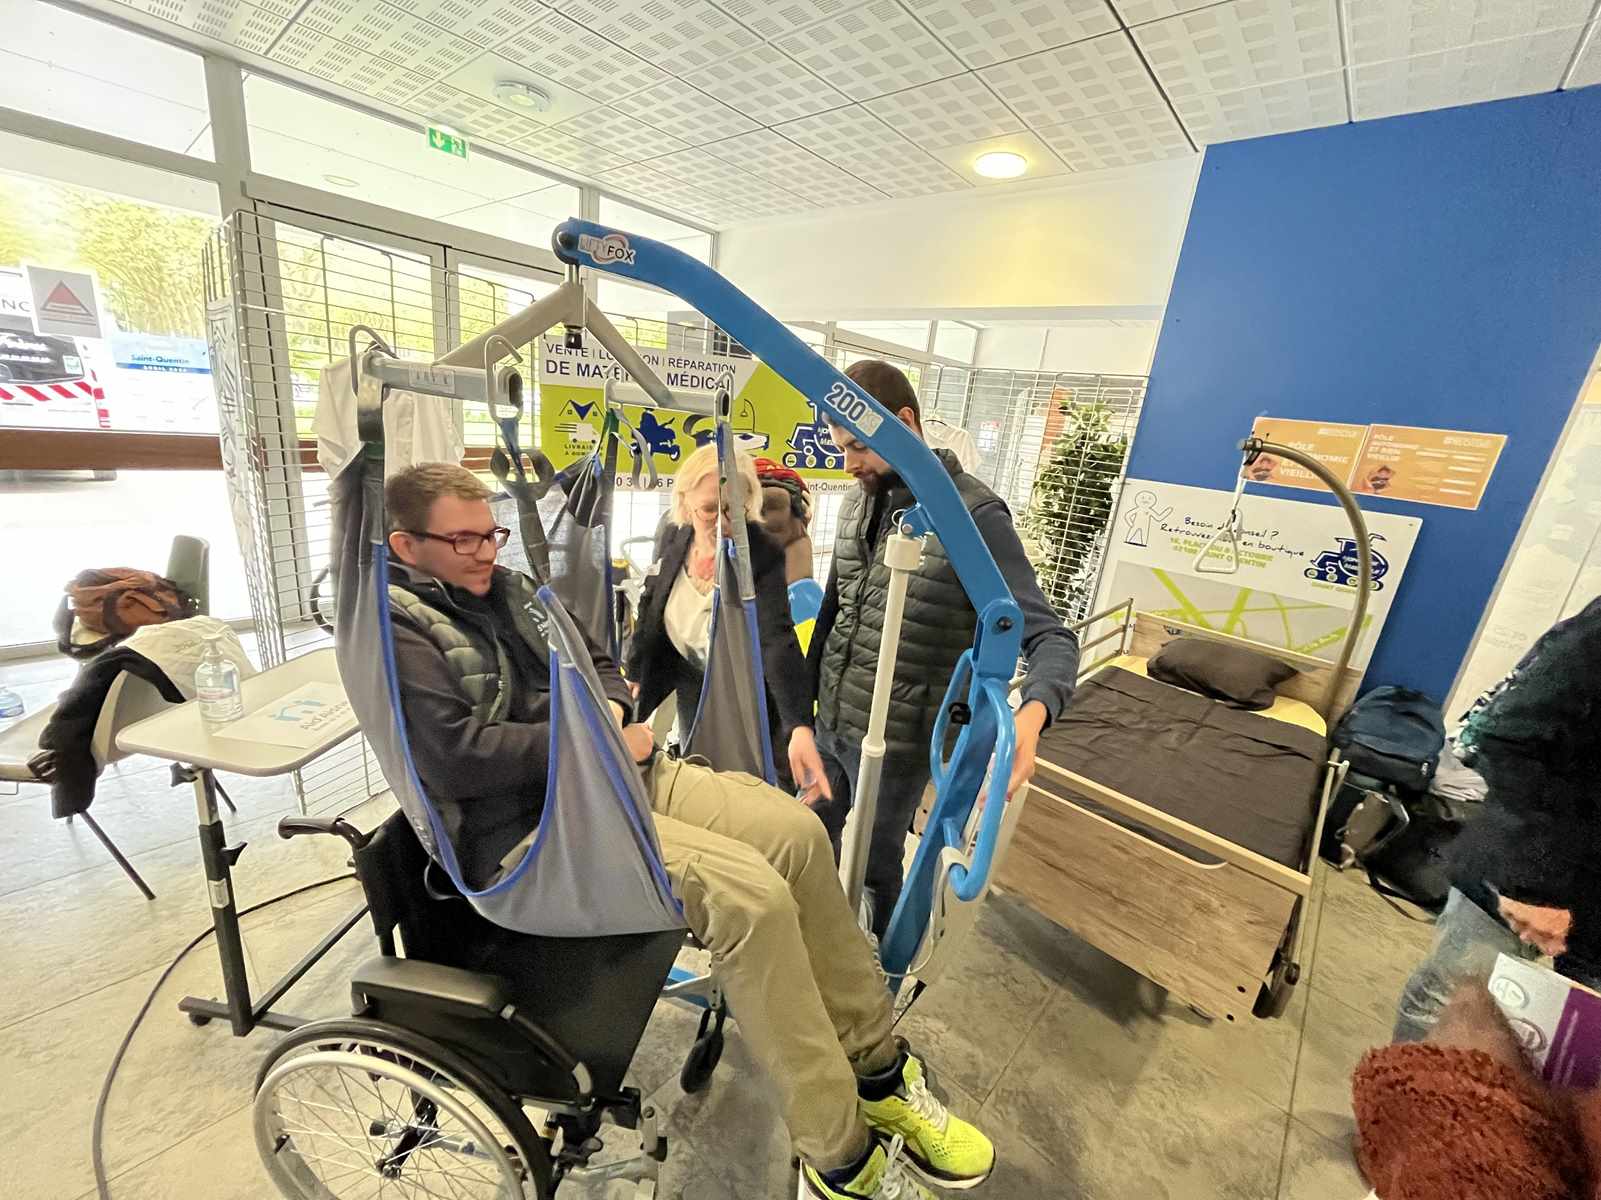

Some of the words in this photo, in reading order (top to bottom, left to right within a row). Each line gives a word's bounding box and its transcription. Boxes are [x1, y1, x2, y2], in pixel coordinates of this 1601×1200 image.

[546, 343, 589, 358] VENTE
[546, 359, 570, 376] DE
[825, 383, 867, 422] 200
[1258, 541, 1304, 559] boutique
